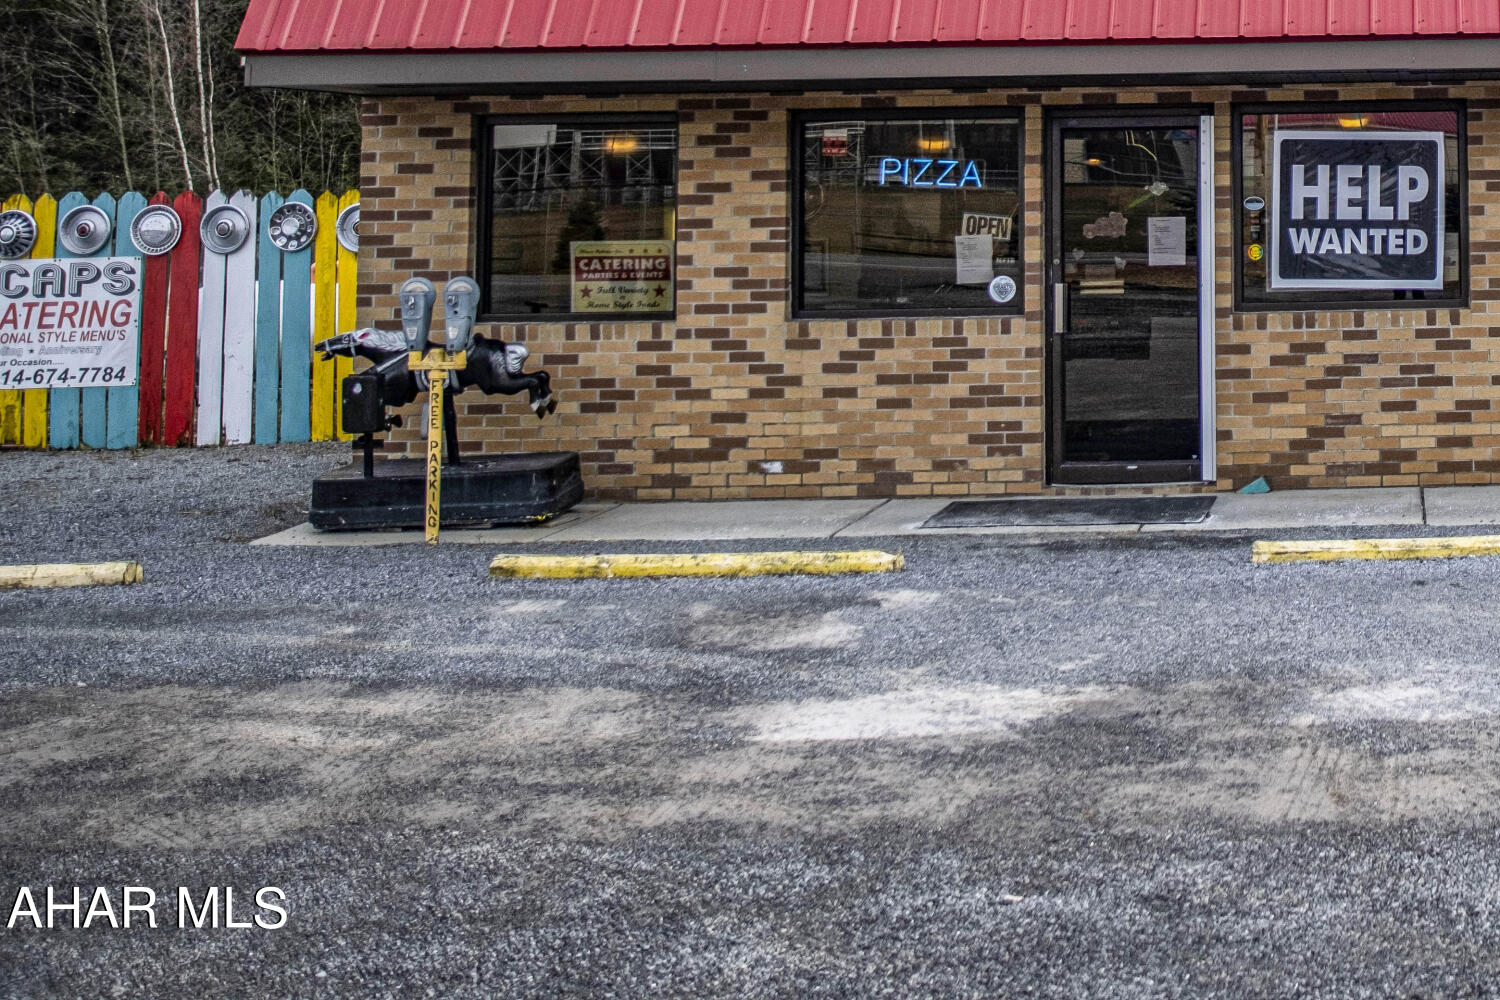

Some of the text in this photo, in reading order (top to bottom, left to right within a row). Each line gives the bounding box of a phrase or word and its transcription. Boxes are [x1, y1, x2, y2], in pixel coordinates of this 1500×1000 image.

[879, 157, 983, 188] PIZZA
[1291, 164, 1430, 220] HELP
[966, 215, 1009, 238] OPEN
[1288, 228, 1428, 256] WANTED
[579, 258, 666, 270] CATERING
[582, 271, 619, 279] PARTIES
[630, 271, 664, 279] EVENTS
[0, 261, 136, 299] CAPS
[597, 286, 616, 294] Full
[38, 331, 77, 343] STYLE
[80, 329, 127, 342] MENU'S
[427, 379, 440, 528] FREE PARKING
